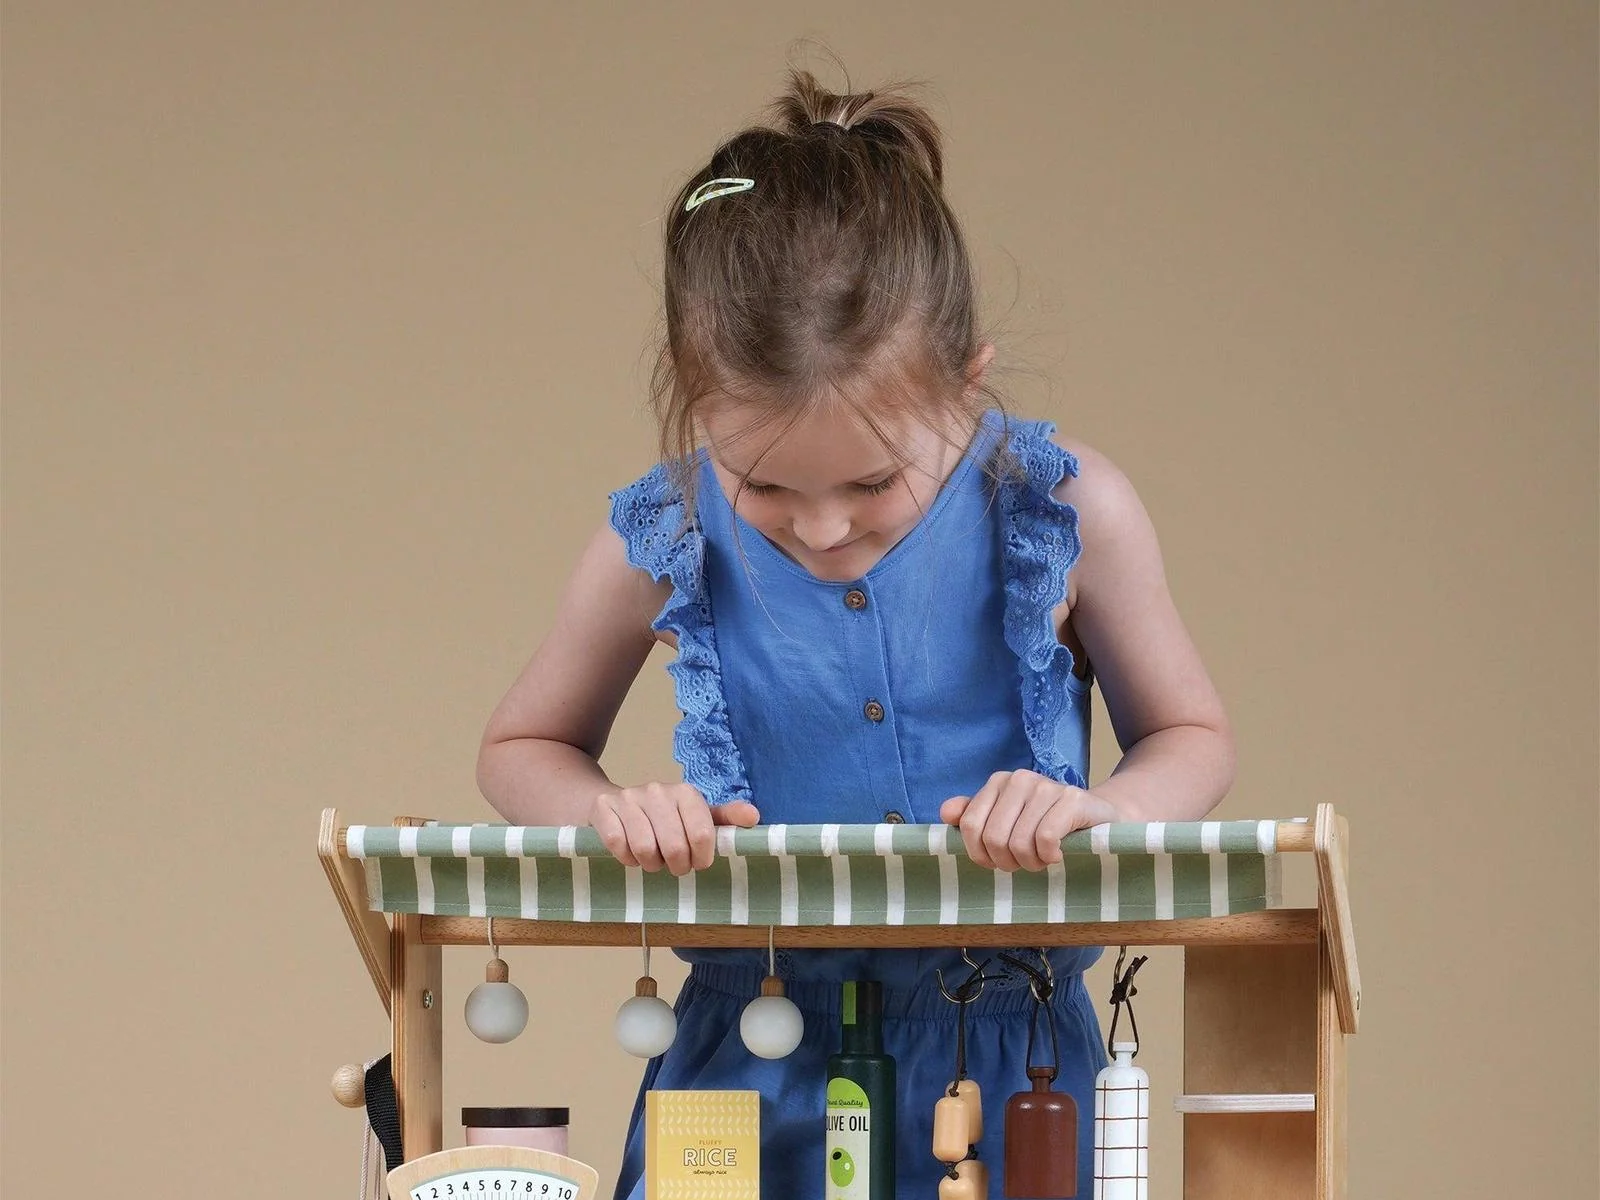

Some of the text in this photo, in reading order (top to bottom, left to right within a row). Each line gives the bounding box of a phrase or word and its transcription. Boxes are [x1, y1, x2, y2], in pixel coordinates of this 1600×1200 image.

[839, 1099, 864, 1107] Quality
[849, 1115, 869, 1132] OIL
[683, 1147, 737, 1167] RICE
[430, 1187, 439, 1199] 2
[447, 1183, 454, 1195] 3
[462, 1181, 470, 1191] 4
[478, 1179, 485, 1191] 5
[494, 1179, 501, 1191] 6
[511, 1179, 517, 1191] 7
[525, 1181, 533, 1192] 8
[541, 1183, 549, 1194] 9
[558, 1187, 572, 1200] 10
